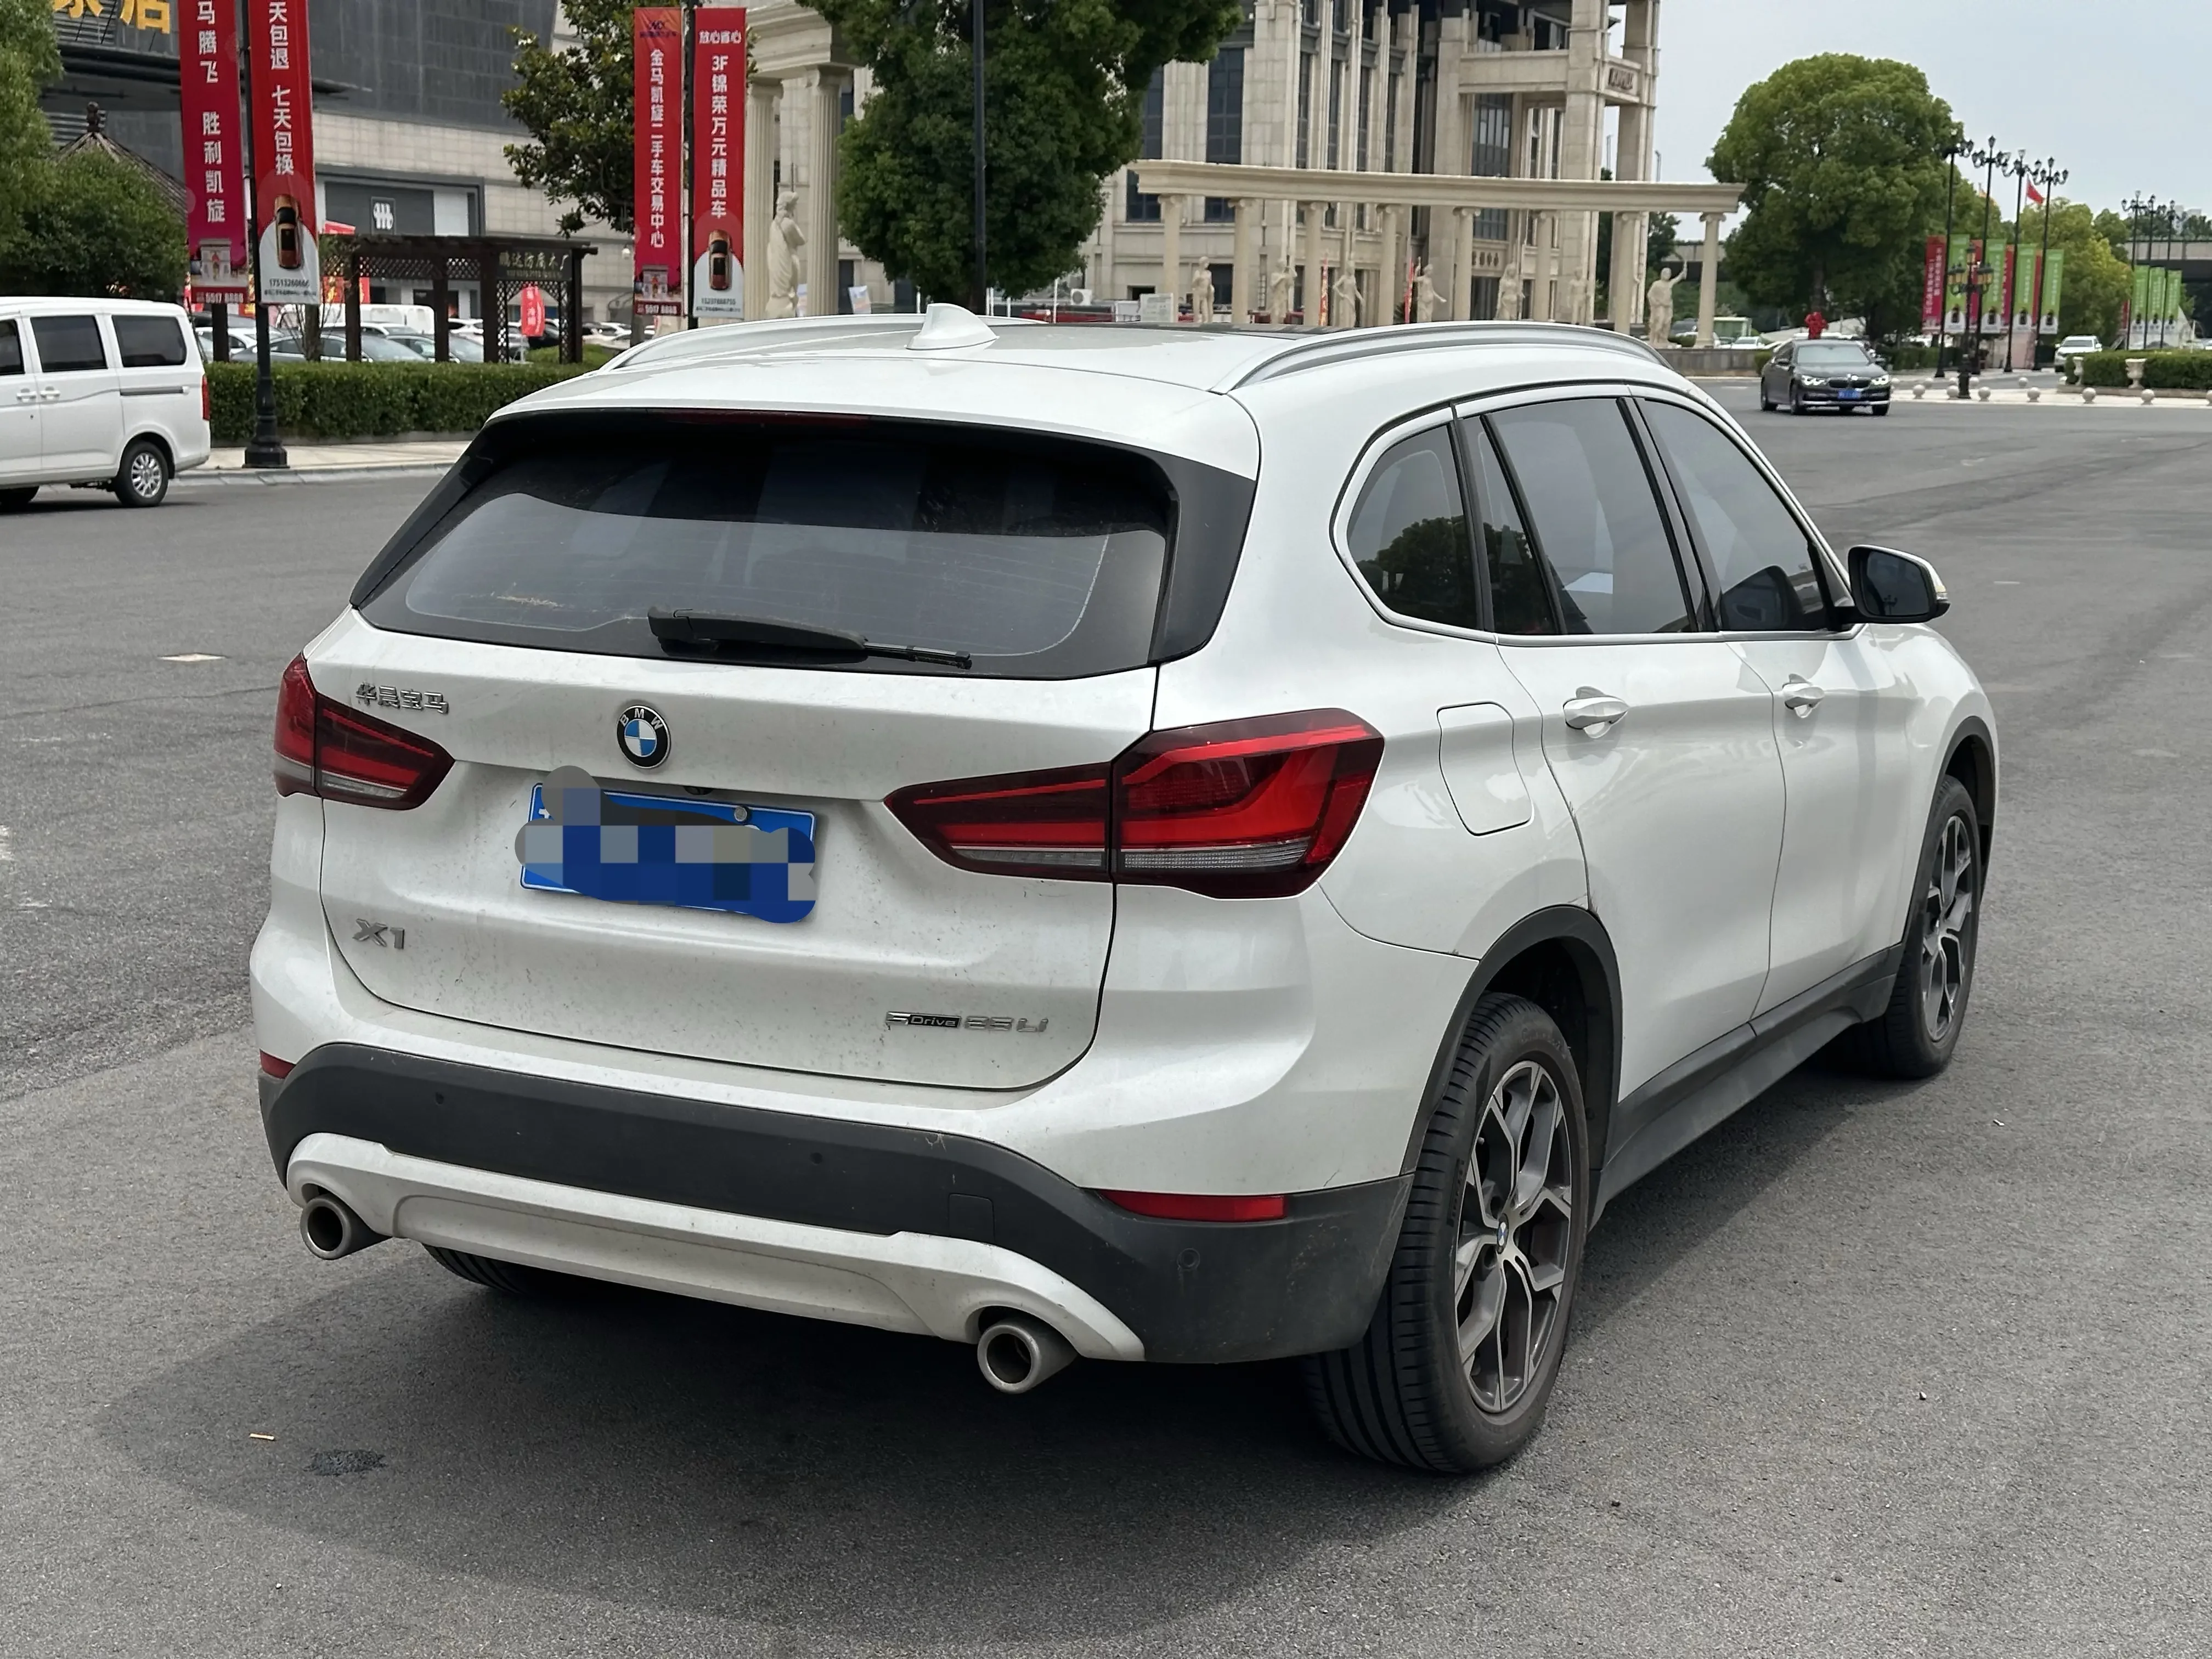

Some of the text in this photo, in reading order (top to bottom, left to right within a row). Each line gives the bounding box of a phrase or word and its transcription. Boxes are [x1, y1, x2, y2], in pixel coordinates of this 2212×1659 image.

[269, 1, 294, 176] 天包退 七天包换
[202, 111, 225, 222] 胜利凯旋
[650, 49, 664, 248] 金马凯旋二手车交易中心
[356, 681, 449, 714] 华晨宝马
[619, 708, 663, 730] BMW
[352, 918, 405, 950] X1
